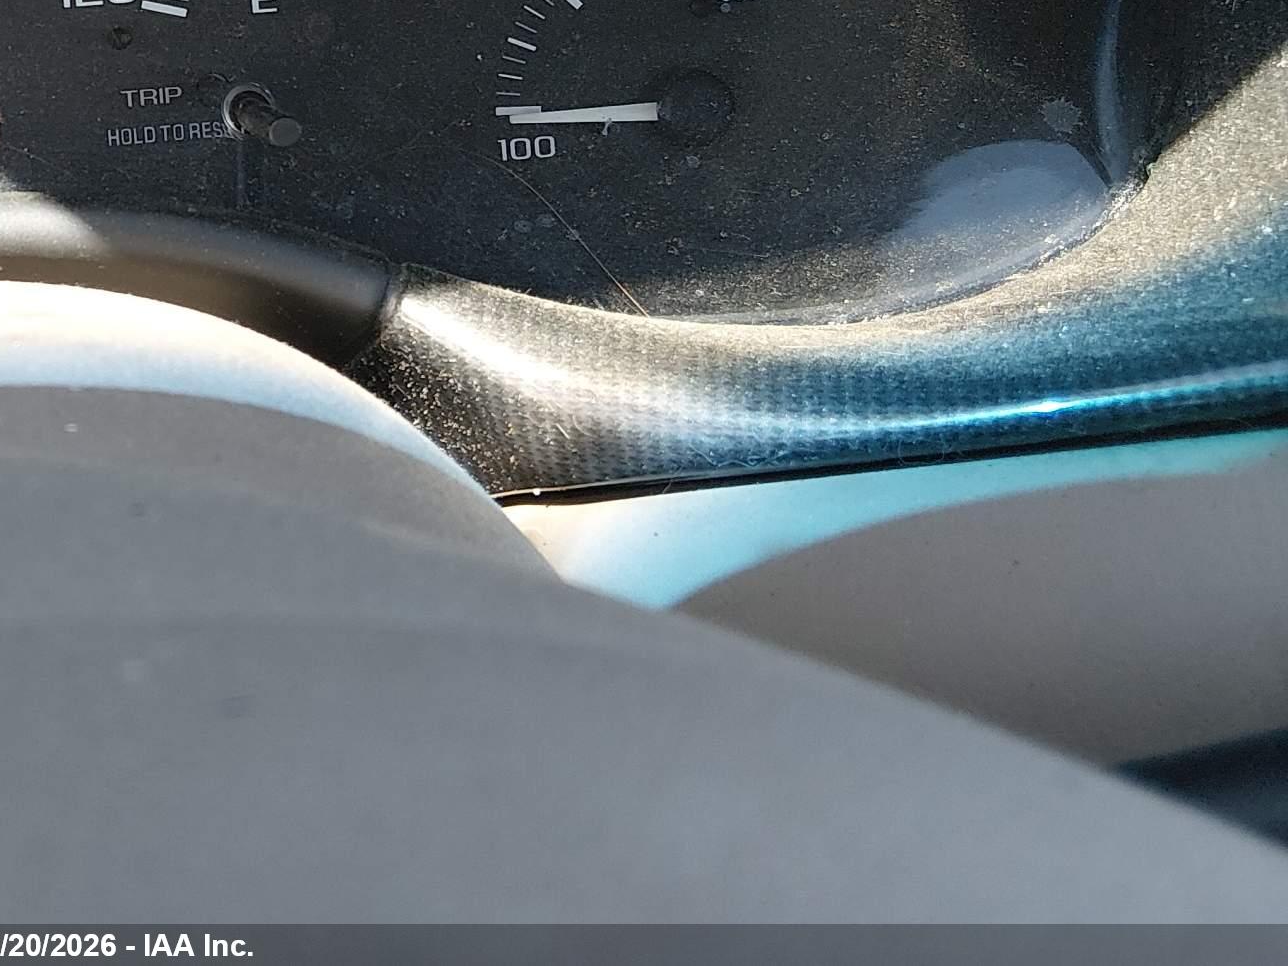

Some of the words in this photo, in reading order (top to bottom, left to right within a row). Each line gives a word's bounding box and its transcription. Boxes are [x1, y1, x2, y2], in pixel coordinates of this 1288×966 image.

[121, 87, 181, 107] TRIP
[108, 127, 155, 146] HOLD
[160, 124, 184, 141] TO
[189, 120, 235, 141] RES
[498, 136, 555, 161] 100
